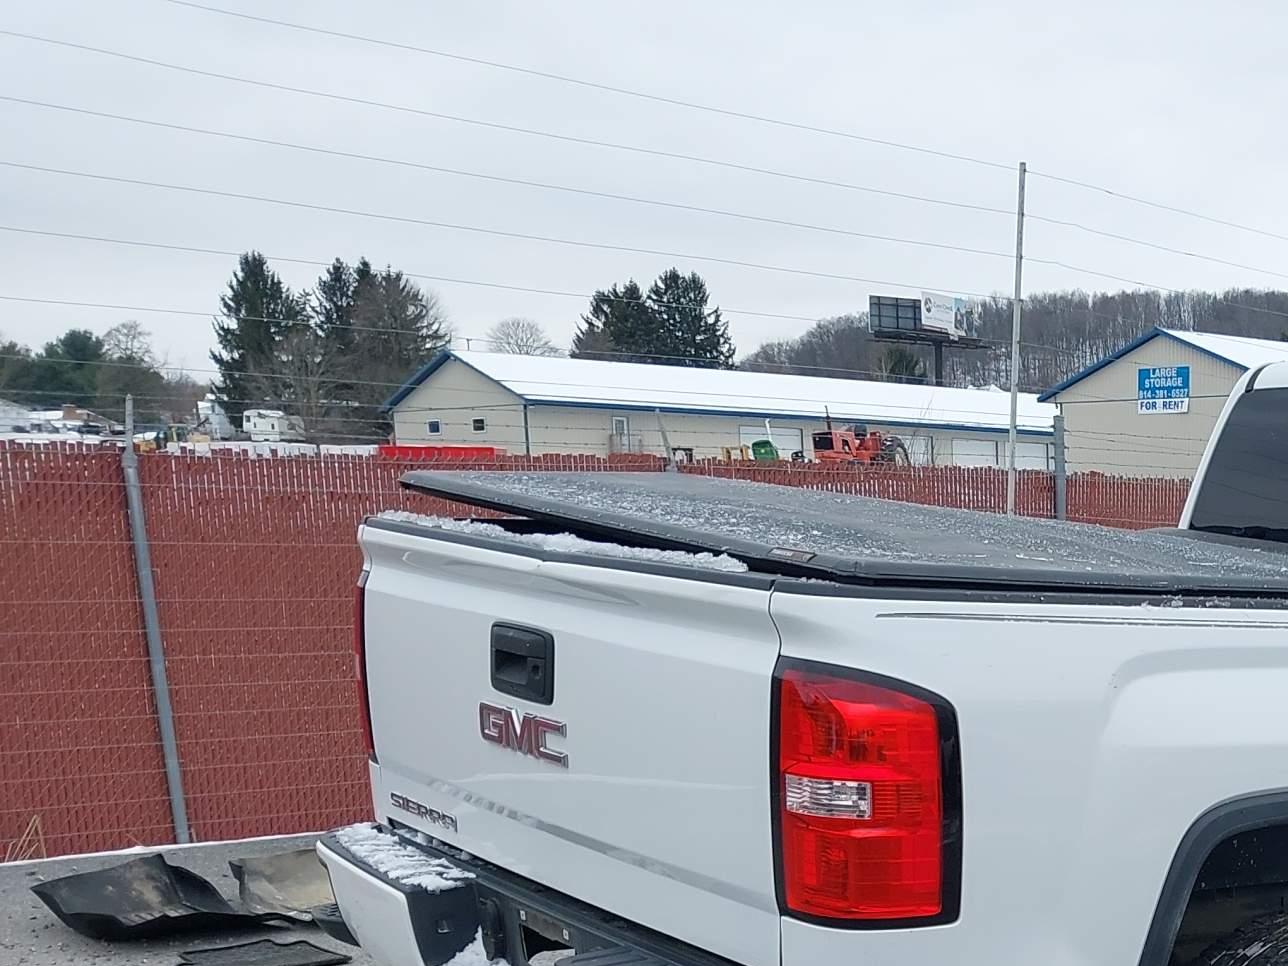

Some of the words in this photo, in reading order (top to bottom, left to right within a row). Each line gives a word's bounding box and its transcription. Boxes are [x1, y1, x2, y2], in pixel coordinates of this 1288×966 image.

[1150, 367, 1177, 378] LARGE
[1144, 377, 1183, 388] STORAGE
[1140, 401, 1157, 411] FOR
[1162, 400, 1185, 411] RENT
[479, 701, 569, 769] GMC
[390, 791, 458, 833] SIERRA
